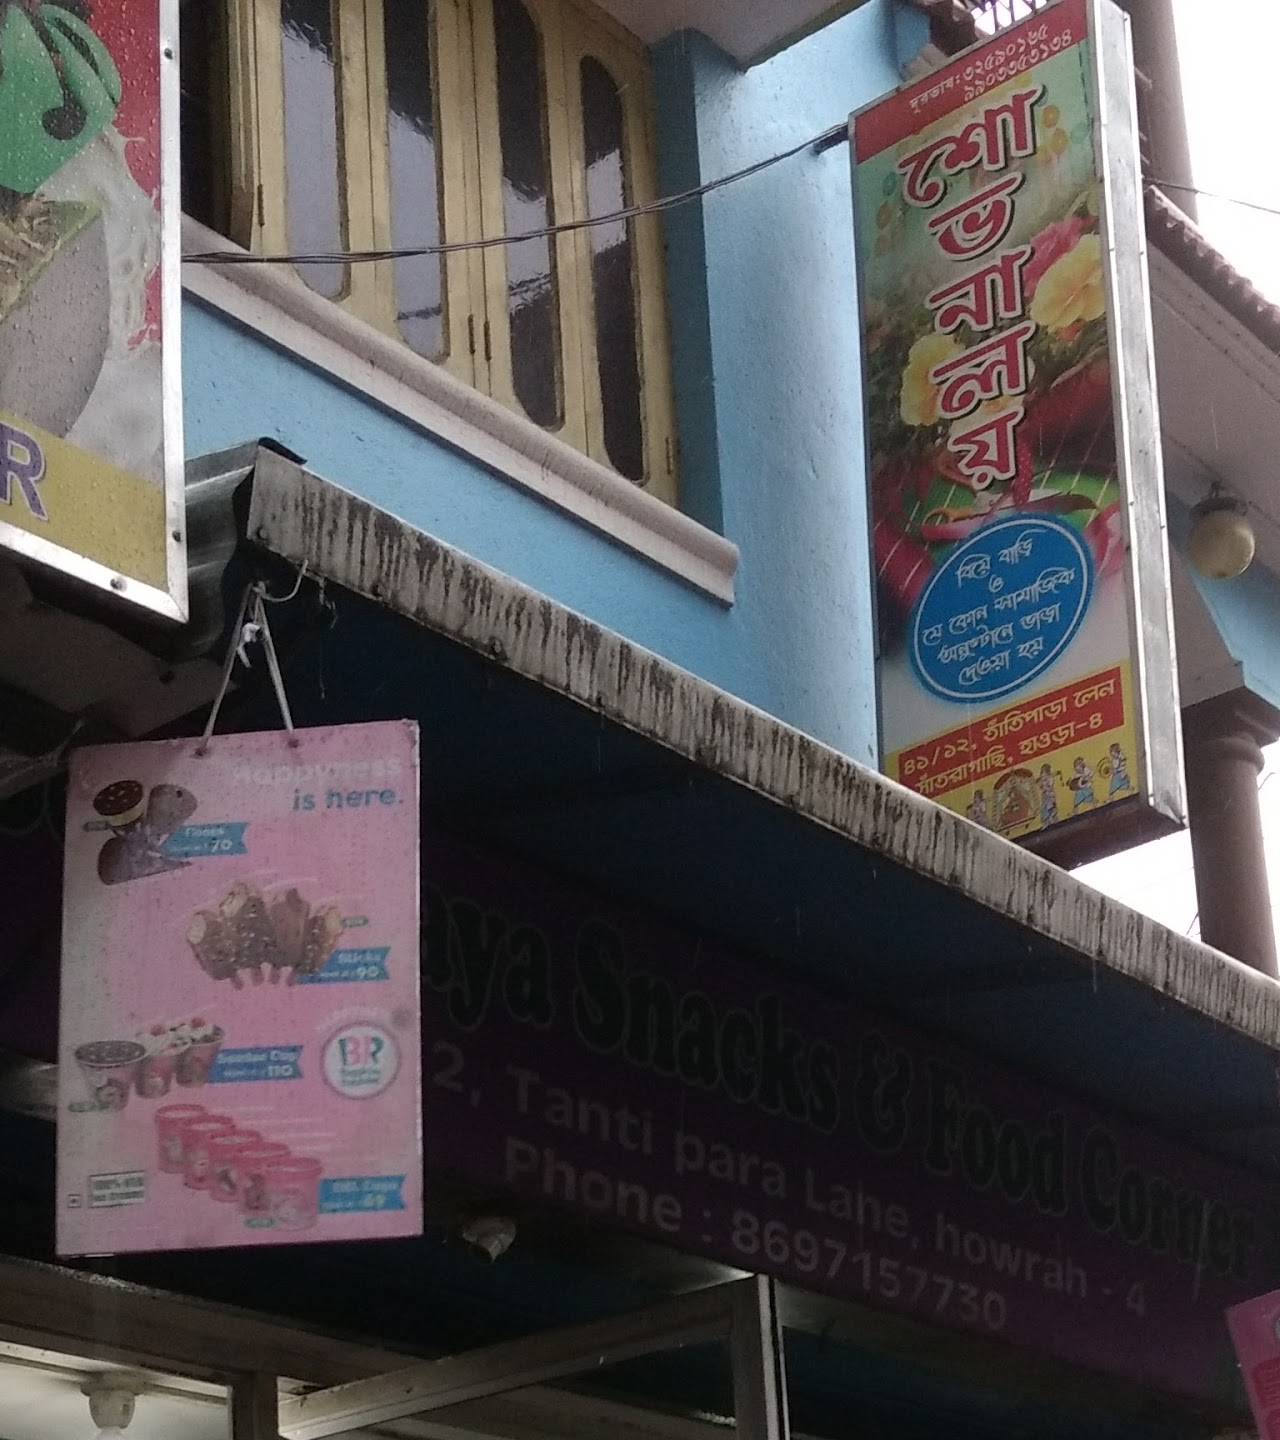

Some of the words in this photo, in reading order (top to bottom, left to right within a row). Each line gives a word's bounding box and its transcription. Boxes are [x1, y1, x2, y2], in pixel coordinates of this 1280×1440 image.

[922, 624, 943, 646] যে
[948, 604, 989, 635] কোন
[994, 567, 1076, 611] সামাজিক
[988, 574, 1005, 593] ও
[1021, 602, 1062, 631] ভাড়া
[958, 650, 1012, 686] দেওয়া
[1017, 636, 1045, 660] হয়
[1073, 679, 1116, 709] লেন
[292, 788, 316, 811] is
[573, 917, 840, 1135] Snacks
[921, 1056, 1070, 1217] Food
[506, 1063, 657, 1155] Tanti
[675, 1130, 787, 1198] para
[936, 1212, 1089, 1299] howrah
[505, 1135, 683, 1233] Phone
[731, 1210, 1008, 1332] 8697157730
